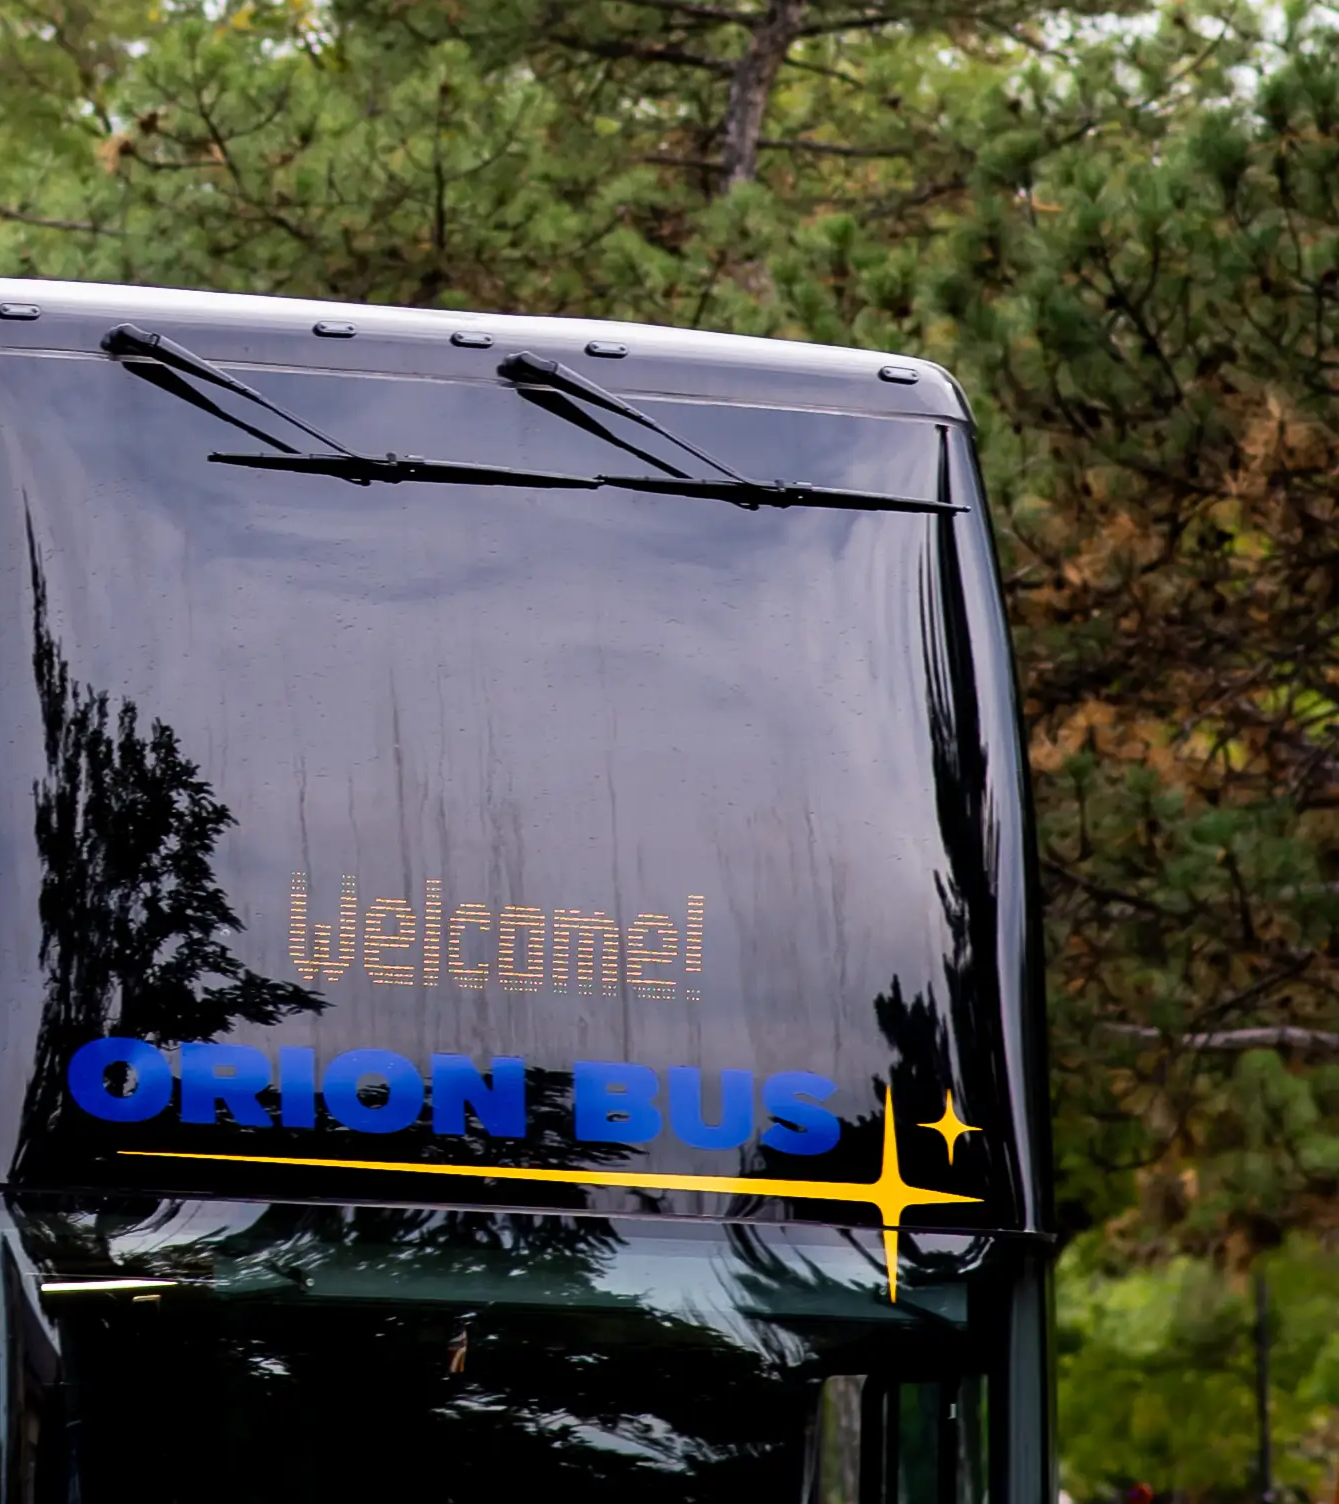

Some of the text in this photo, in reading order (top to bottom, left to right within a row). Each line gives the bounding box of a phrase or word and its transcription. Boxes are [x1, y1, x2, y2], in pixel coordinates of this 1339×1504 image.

[289, 872, 706, 1001] Welcome!
[68, 1037, 841, 1155] ORION BUS
